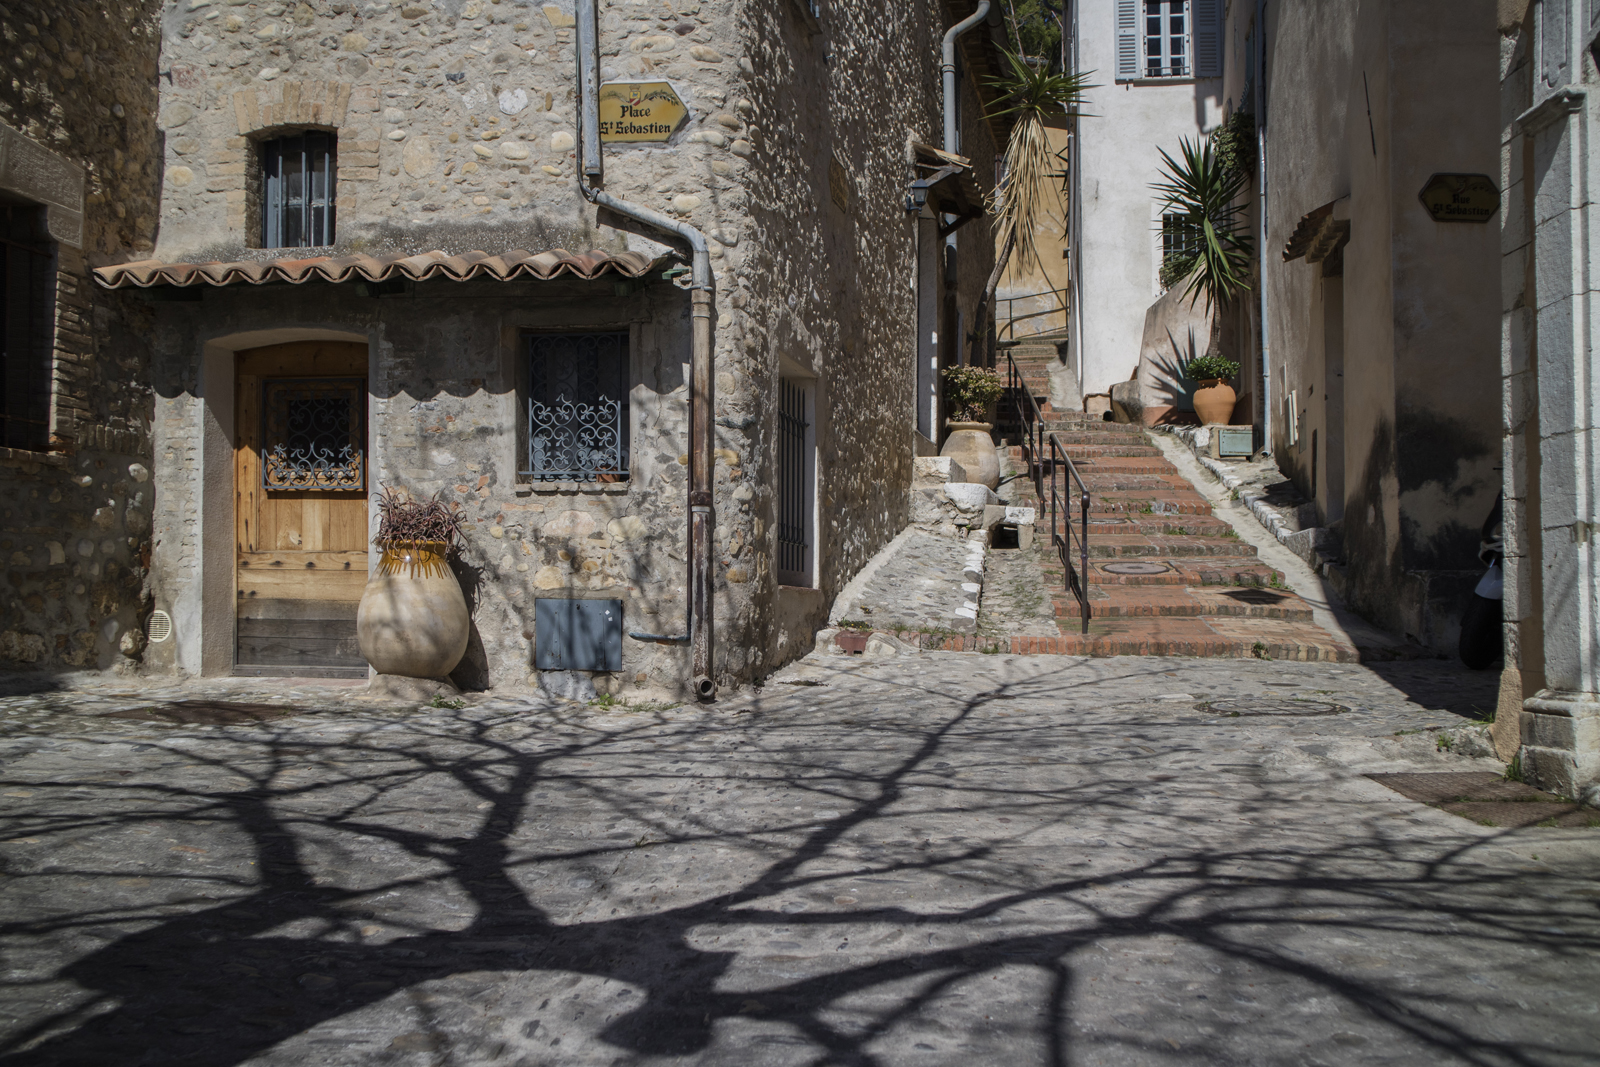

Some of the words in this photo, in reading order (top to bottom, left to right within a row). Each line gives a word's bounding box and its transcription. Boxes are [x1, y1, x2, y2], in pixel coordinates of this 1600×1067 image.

[620, 105, 651, 118] Place
[600, 121, 613, 134] St
[615, 121, 671, 134] Sebastien
[1452, 194, 1470, 203] Rue
[1432, 203, 1443, 213] St
[1446, 203, 1489, 215] Sebastien
